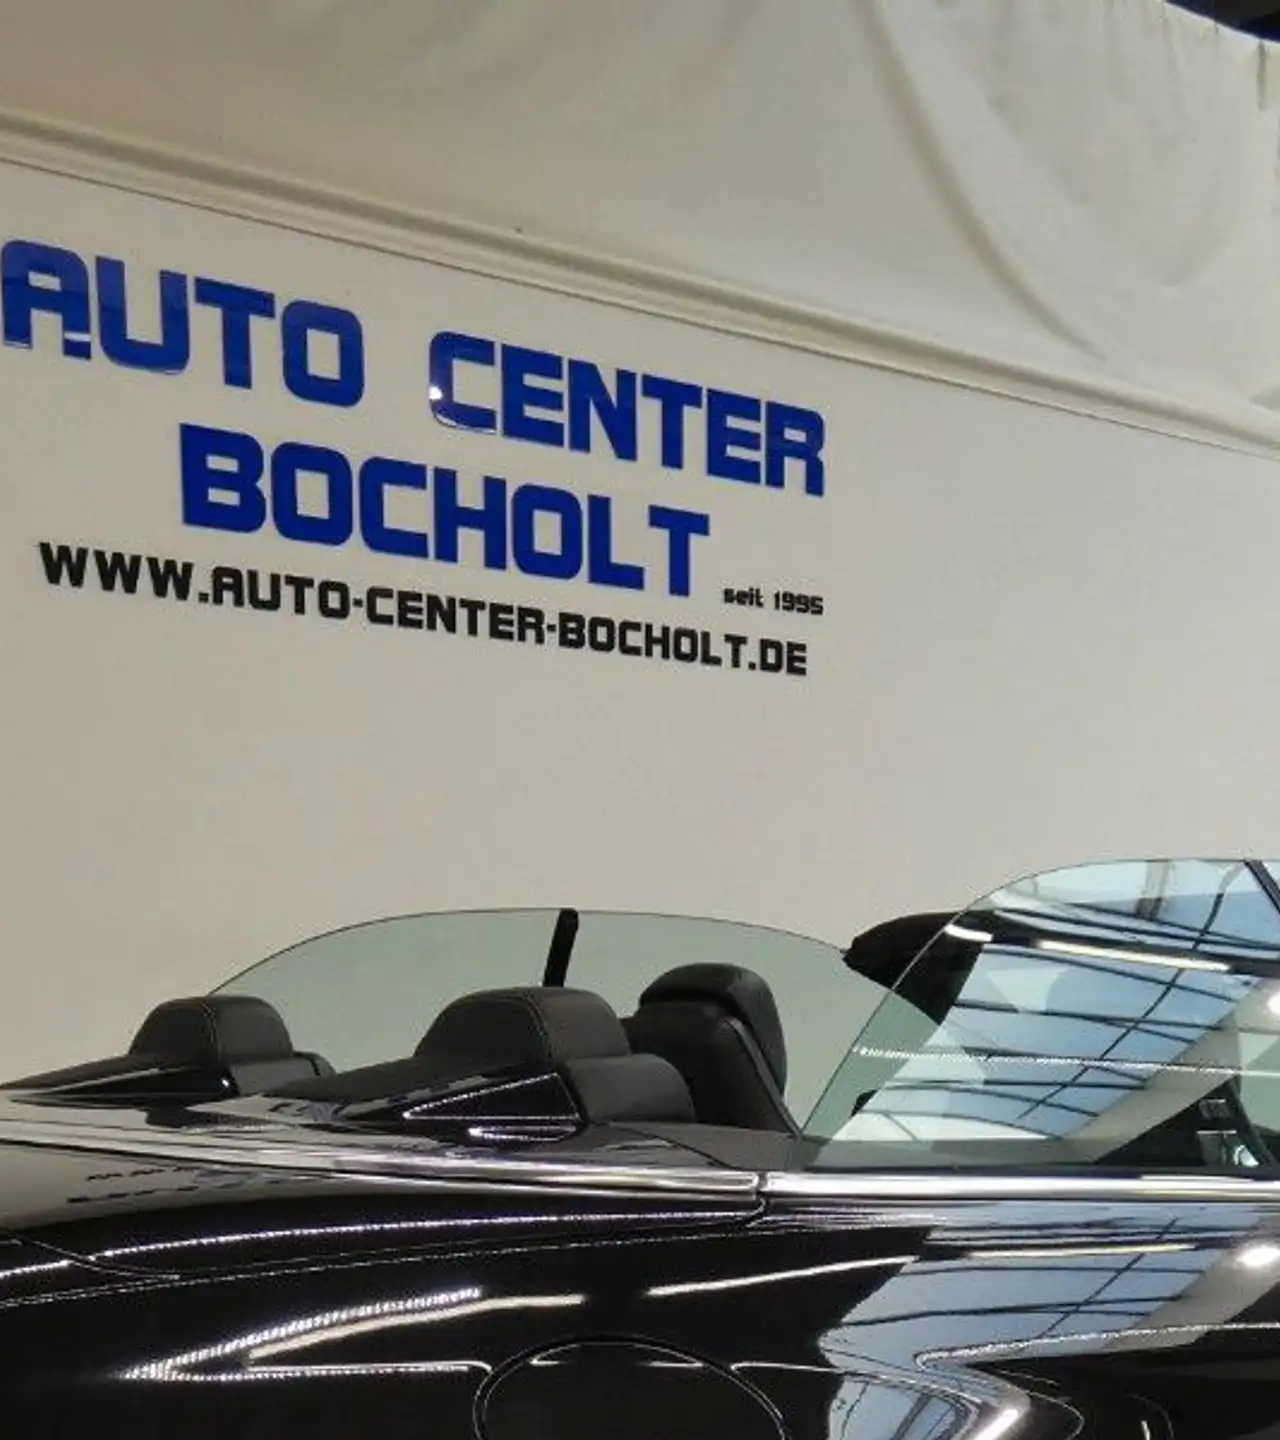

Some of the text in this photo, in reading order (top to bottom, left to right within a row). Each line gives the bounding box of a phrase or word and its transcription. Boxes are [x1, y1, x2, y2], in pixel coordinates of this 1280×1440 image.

[0, 239, 825, 498] AUTO CENTER
[179, 422, 710, 598] BOCHOLT
[38, 541, 808, 677] WWW.AUTO-CENTER-BOCHOLT.DE
[723, 586, 824, 616] seit 1995
